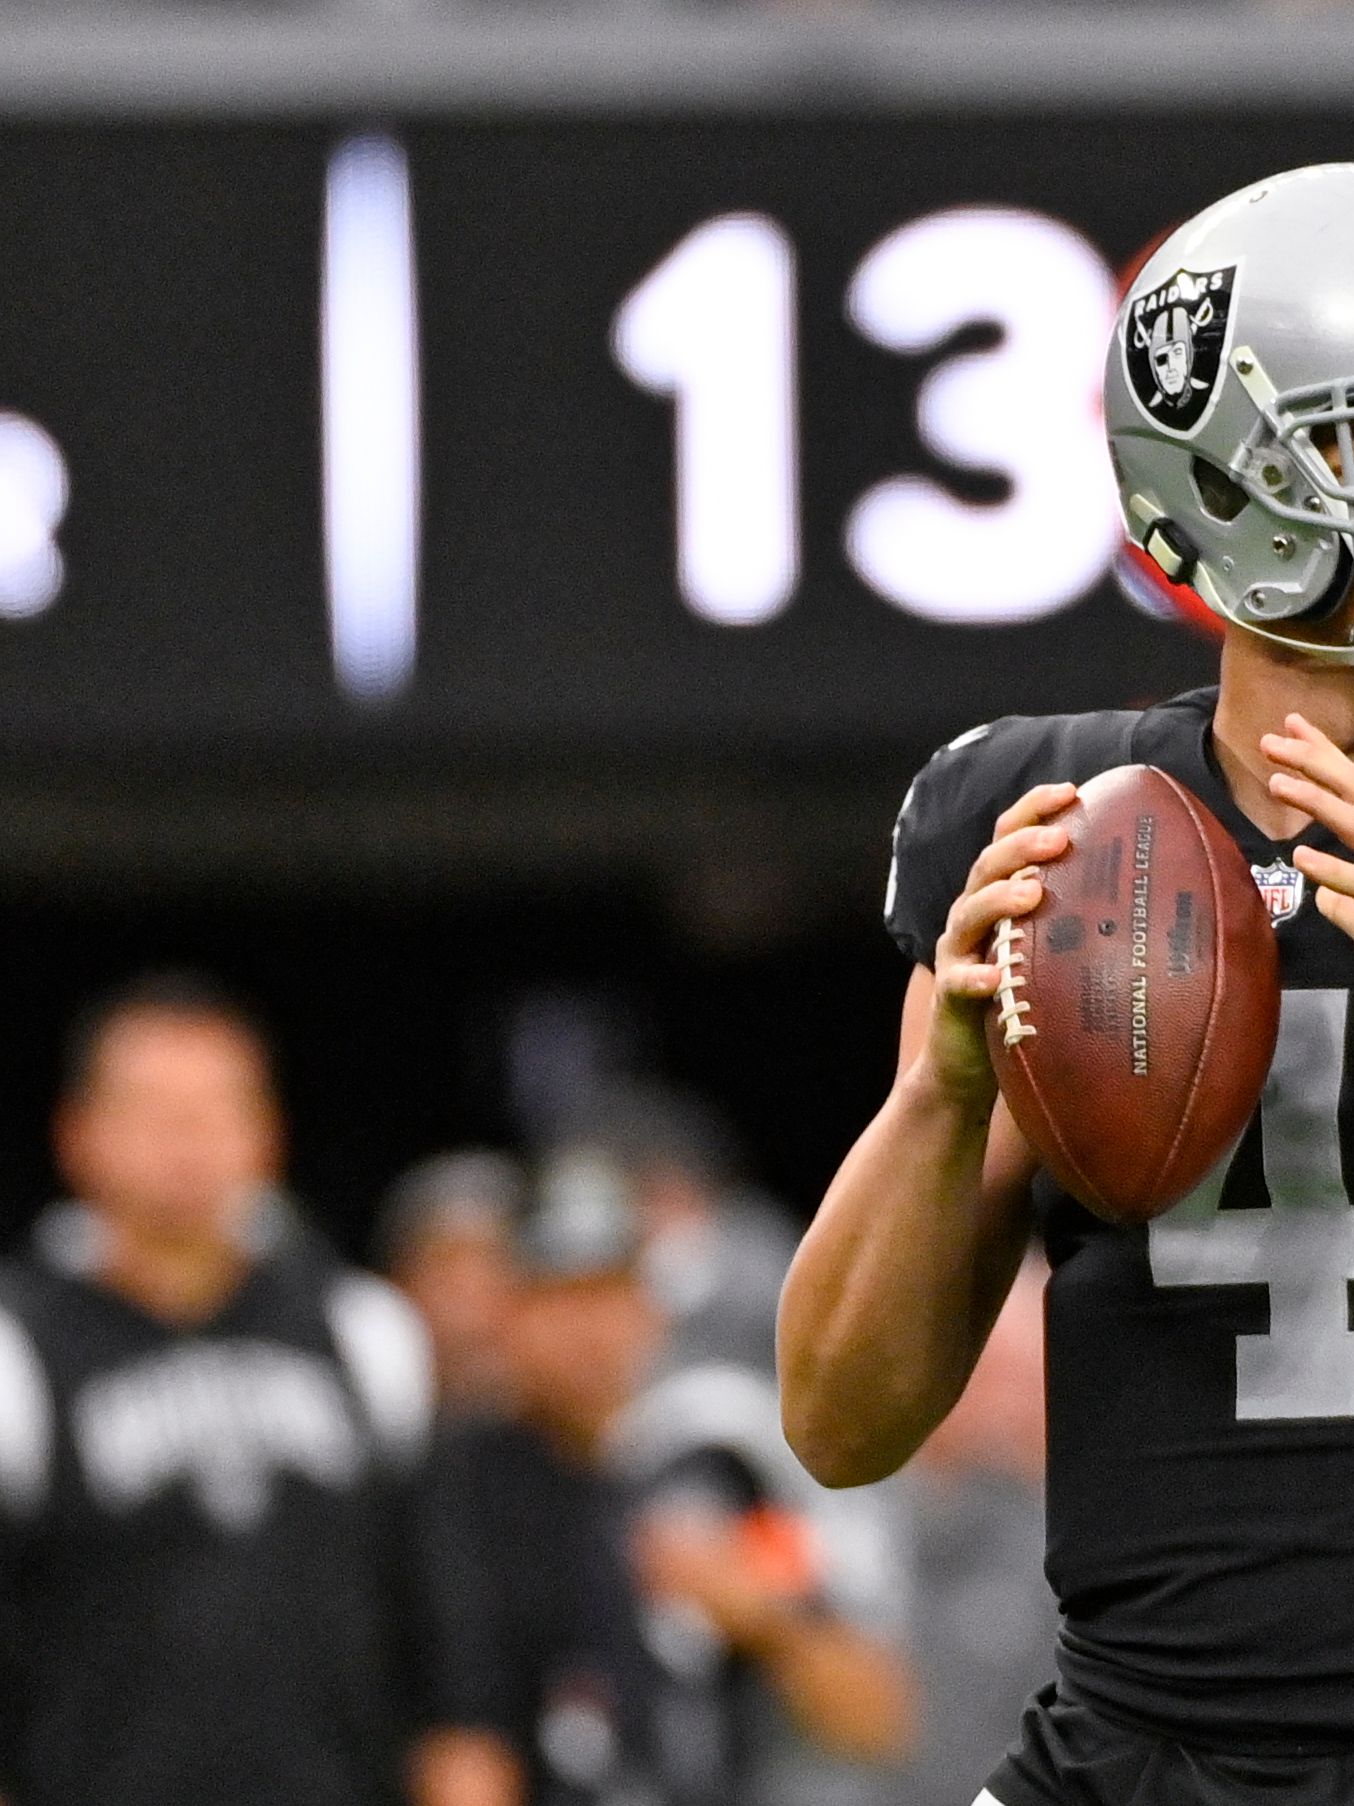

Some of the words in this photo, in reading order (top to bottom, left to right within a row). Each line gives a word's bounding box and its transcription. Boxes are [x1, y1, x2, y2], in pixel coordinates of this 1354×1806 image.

[1134, 271, 1223, 317] RAIDRS
[610, 203, 1117, 624] 13
[1135, 816, 1153, 869] LEAGUE
[1132, 875, 1149, 968] FOOTBALL
[1132, 976, 1148, 1077] NATIONAL
